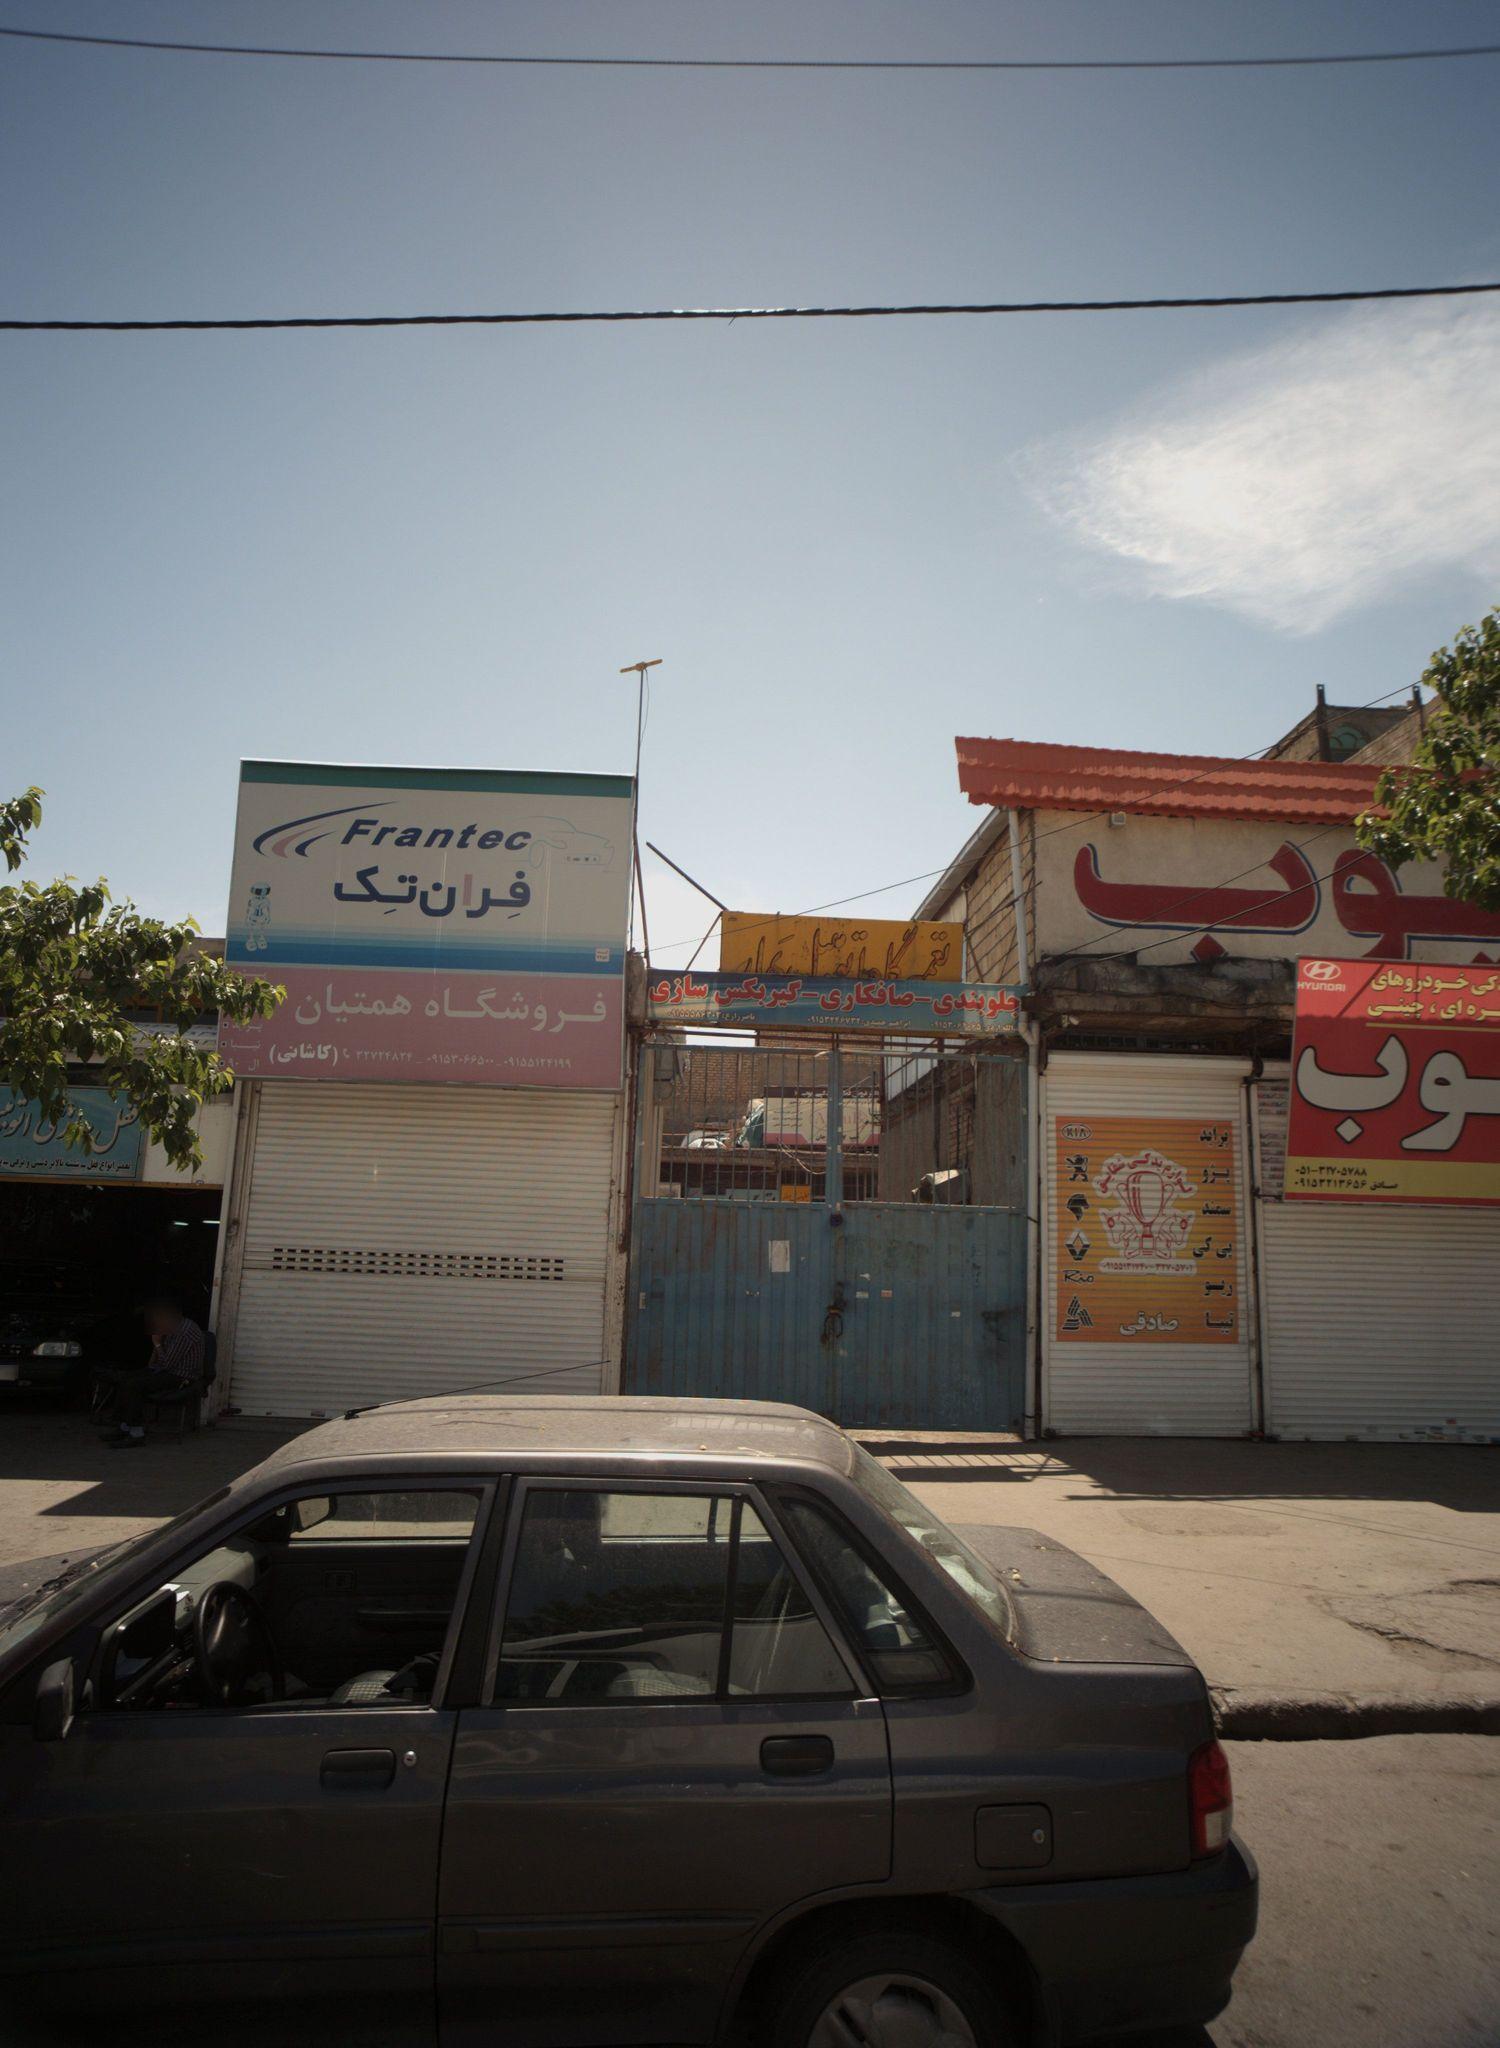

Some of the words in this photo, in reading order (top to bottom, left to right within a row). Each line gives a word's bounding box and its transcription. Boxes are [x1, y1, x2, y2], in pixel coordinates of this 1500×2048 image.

[341, 819, 532, 850] Frantec
[649, 975, 709, 1004] سازی
[714, 978, 802, 1008] گیربکس
[819, 980, 914, 1012] صافکاری
[1297, 982, 1346, 992] HYUNDAI
[294, 984, 412, 1025] همتیان
[424, 987, 606, 1033] فروشگاه
[1367, 999, 1425, 1019] چینی
[1066, 1128, 1087, 1137] KIA
[1062, 1268, 1095, 1283] Rio
[1119, 1311, 1180, 1336] صادقی
